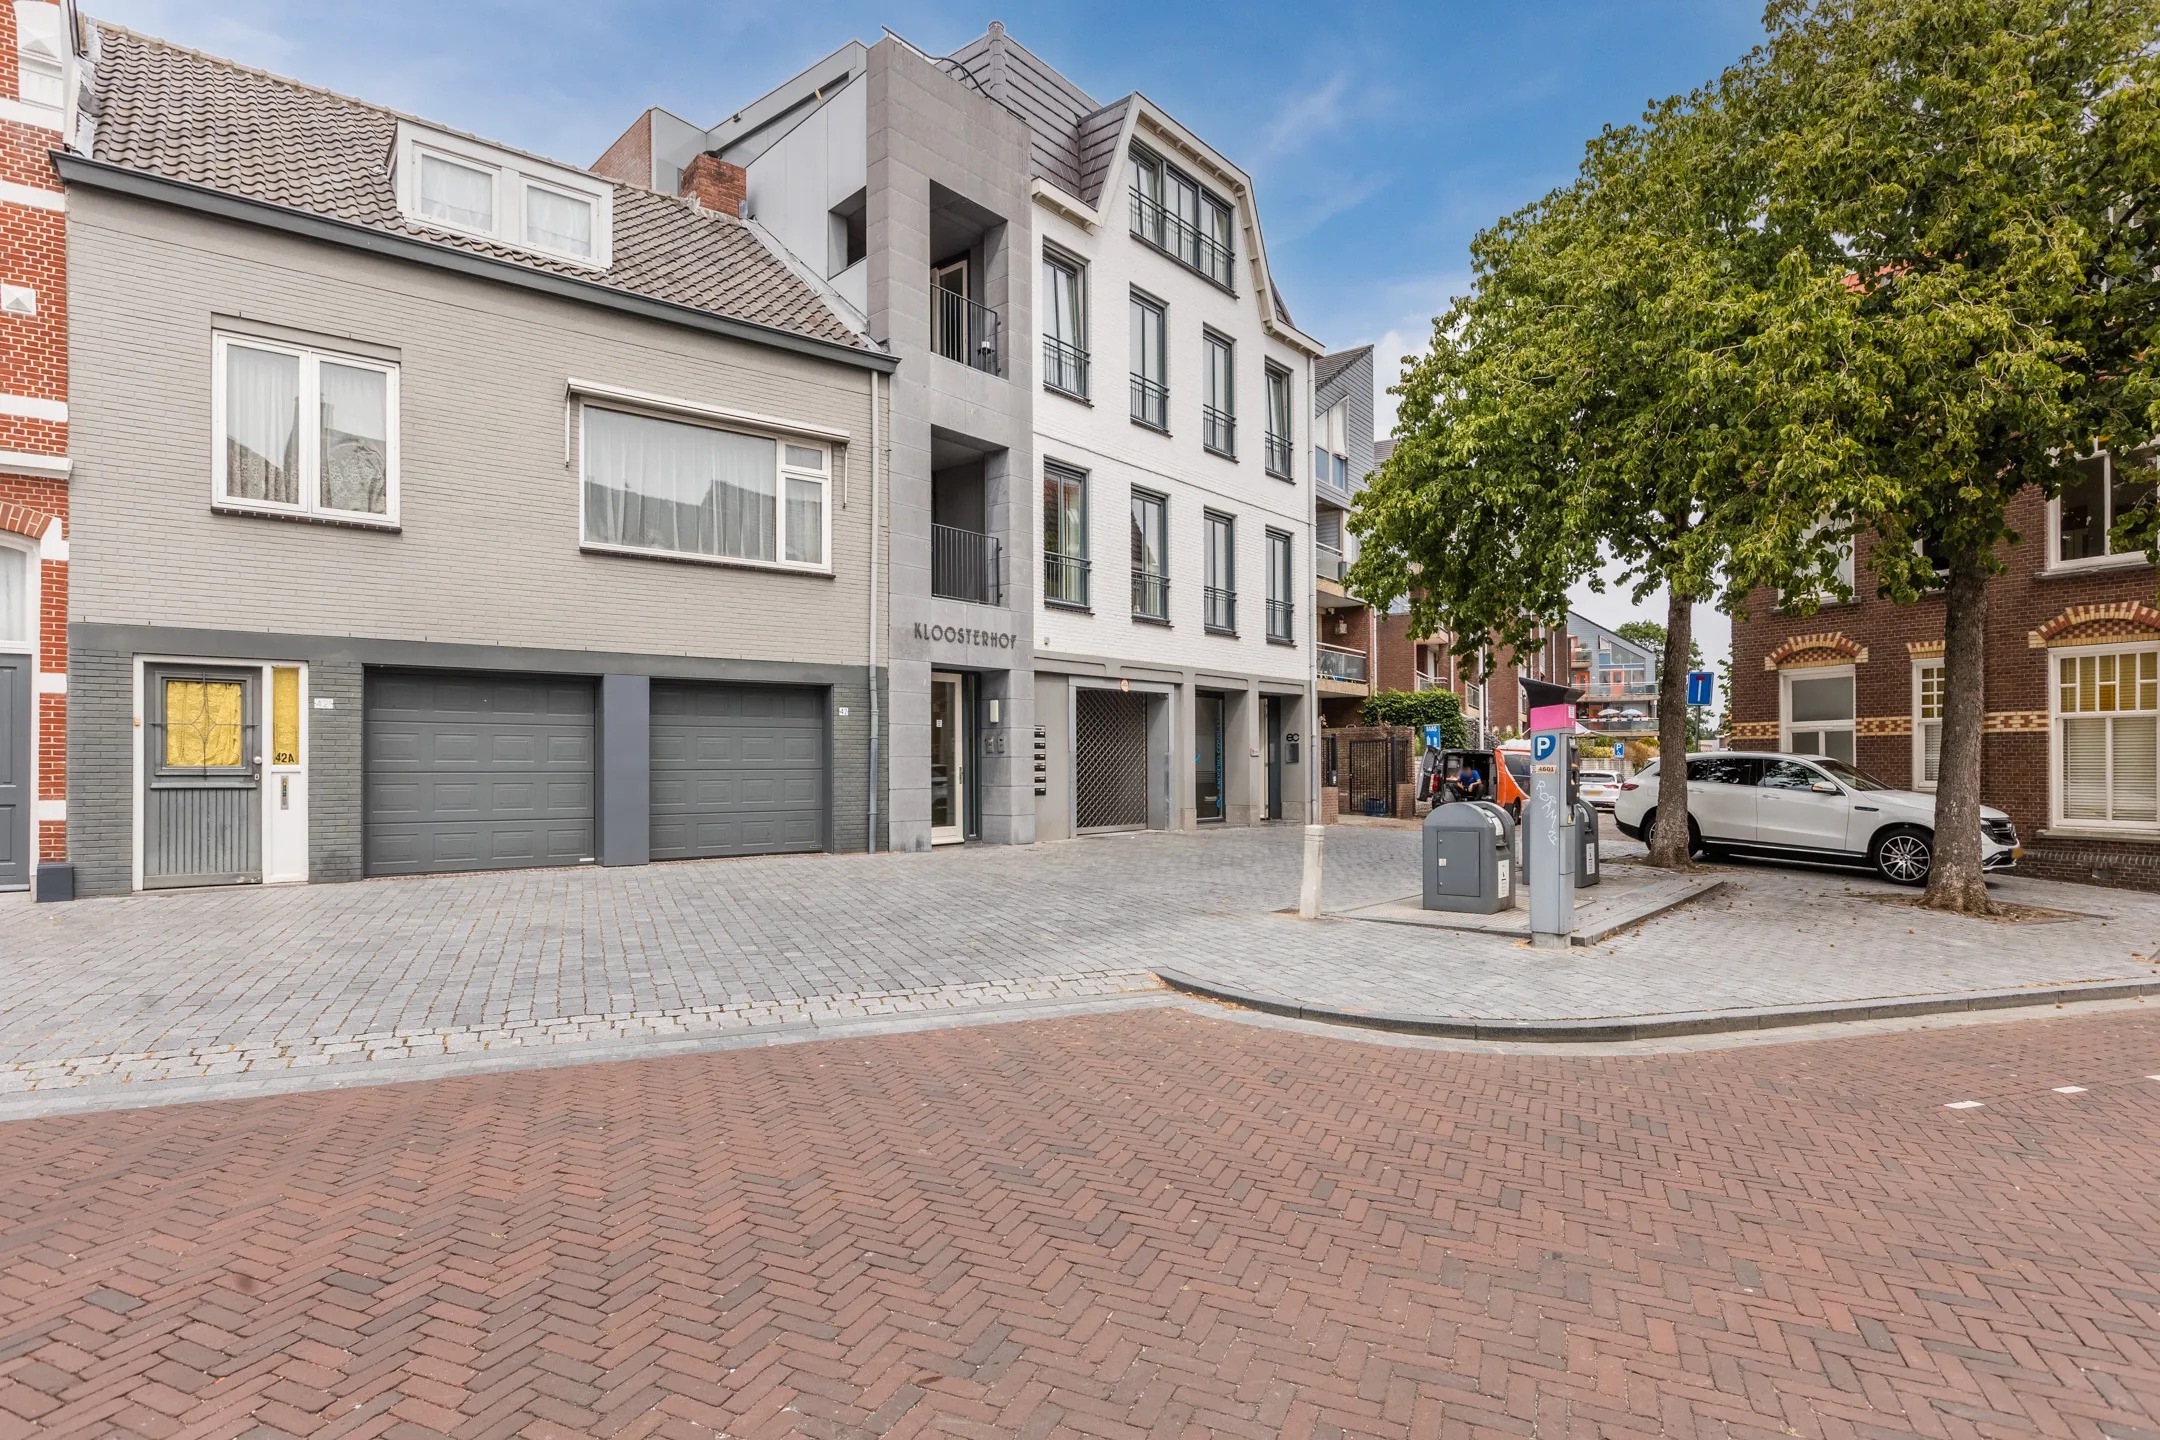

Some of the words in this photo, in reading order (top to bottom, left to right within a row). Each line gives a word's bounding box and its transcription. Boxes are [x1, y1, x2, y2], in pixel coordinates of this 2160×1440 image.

[914, 622, 1017, 649] KLOOSTERHOF
[1286, 733, 1300, 742] ec
[1537, 737, 1550, 756] P
[275, 752, 294, 763] 42A
